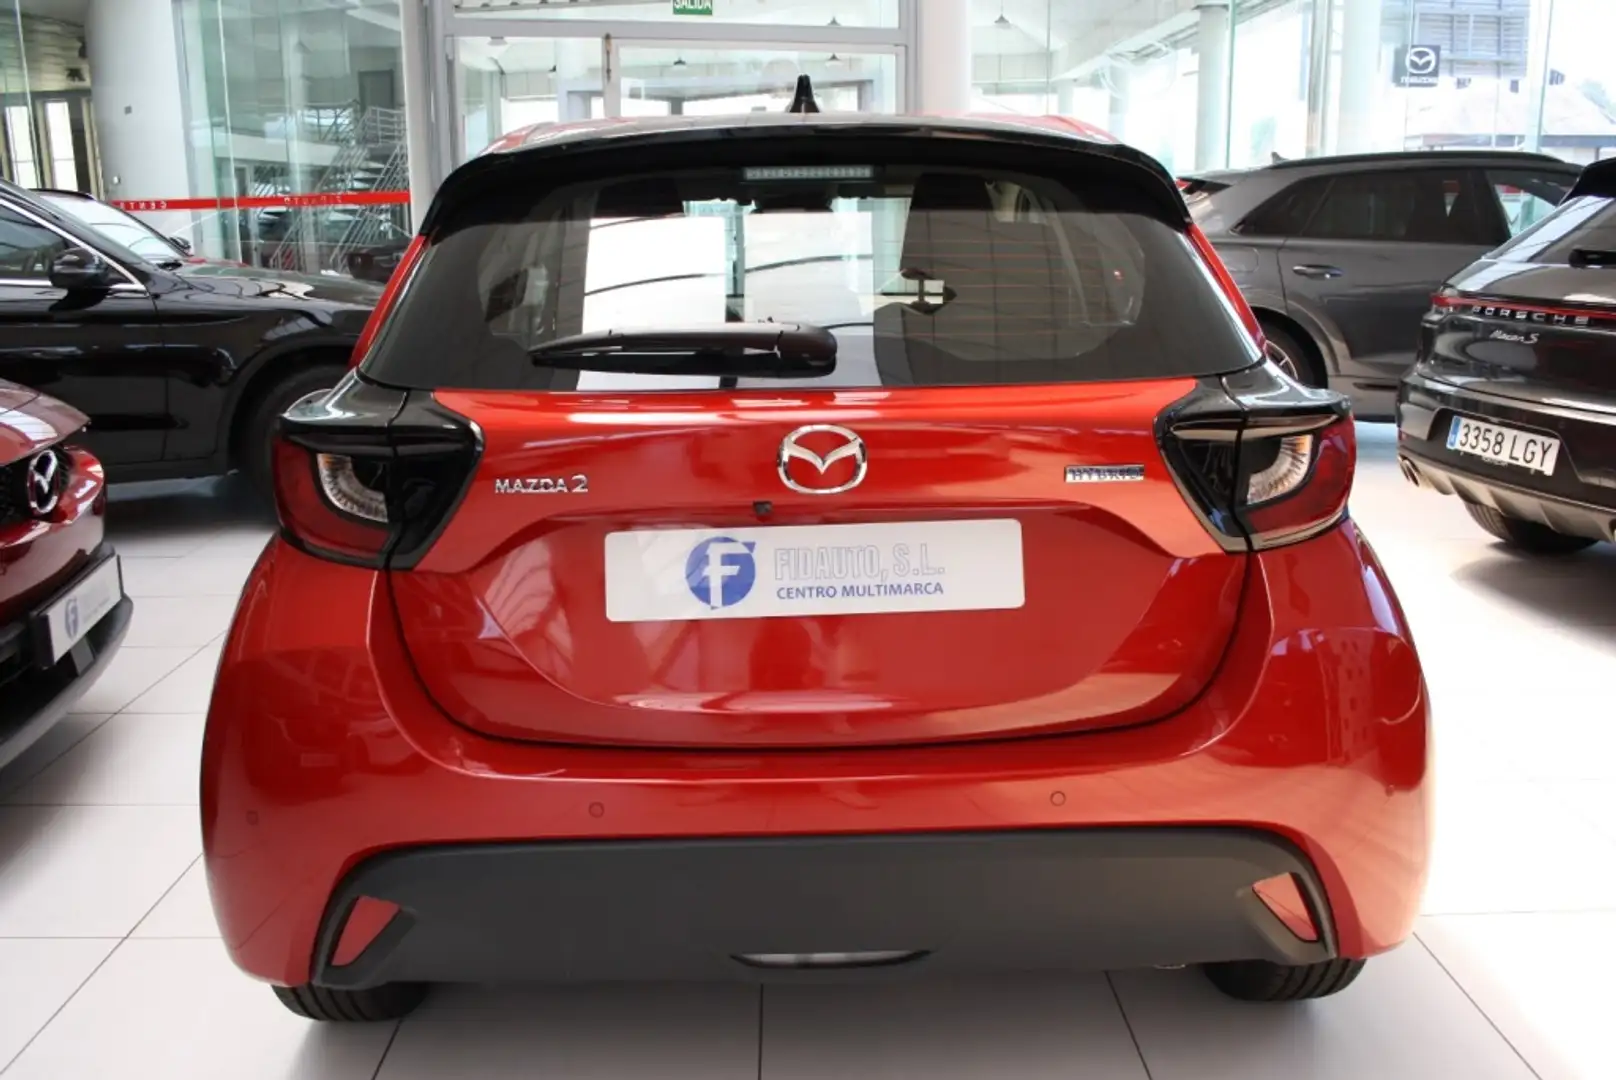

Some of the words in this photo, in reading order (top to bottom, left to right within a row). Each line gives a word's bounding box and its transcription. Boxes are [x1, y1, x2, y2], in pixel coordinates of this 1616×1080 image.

[674, 0, 711, 9] SALIDA
[1472, 305, 1589, 325] PORSCHE
[1525, 332, 1540, 344] S
[1460, 423, 1505, 456] 3358
[1509, 434, 1553, 468] LGY
[495, 478, 568, 493] MAZDA
[572, 474, 588, 493] 2
[774, 544, 889, 583] FIDAUTO,
[892, 542, 946, 578] S.L.
[776, 585, 837, 600] CENTRO
[841, 582, 944, 598] MULTIMARCA
